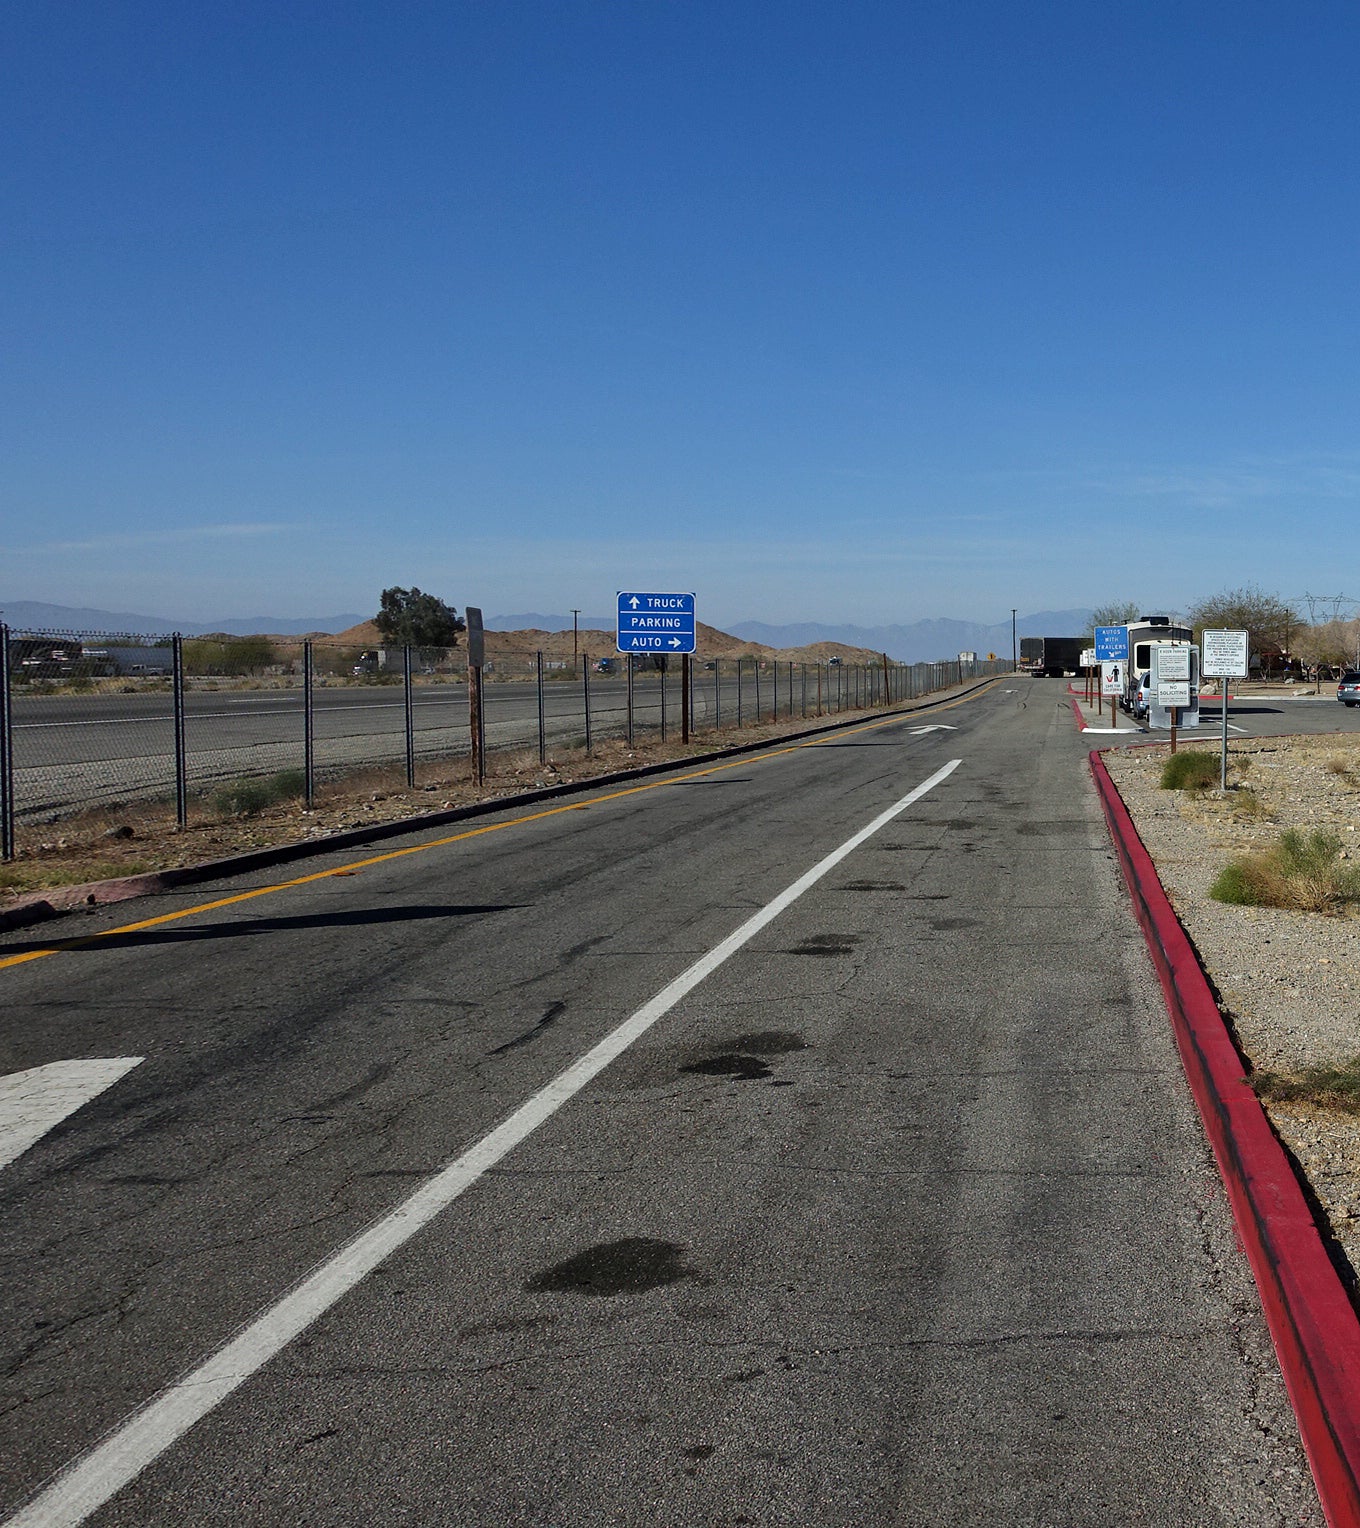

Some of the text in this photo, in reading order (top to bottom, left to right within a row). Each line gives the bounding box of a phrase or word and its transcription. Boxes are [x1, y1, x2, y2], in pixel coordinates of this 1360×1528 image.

[647, 598, 683, 608] TRUCK
[631, 617, 681, 628] PARKING
[631, 637, 662, 647] AUTO
